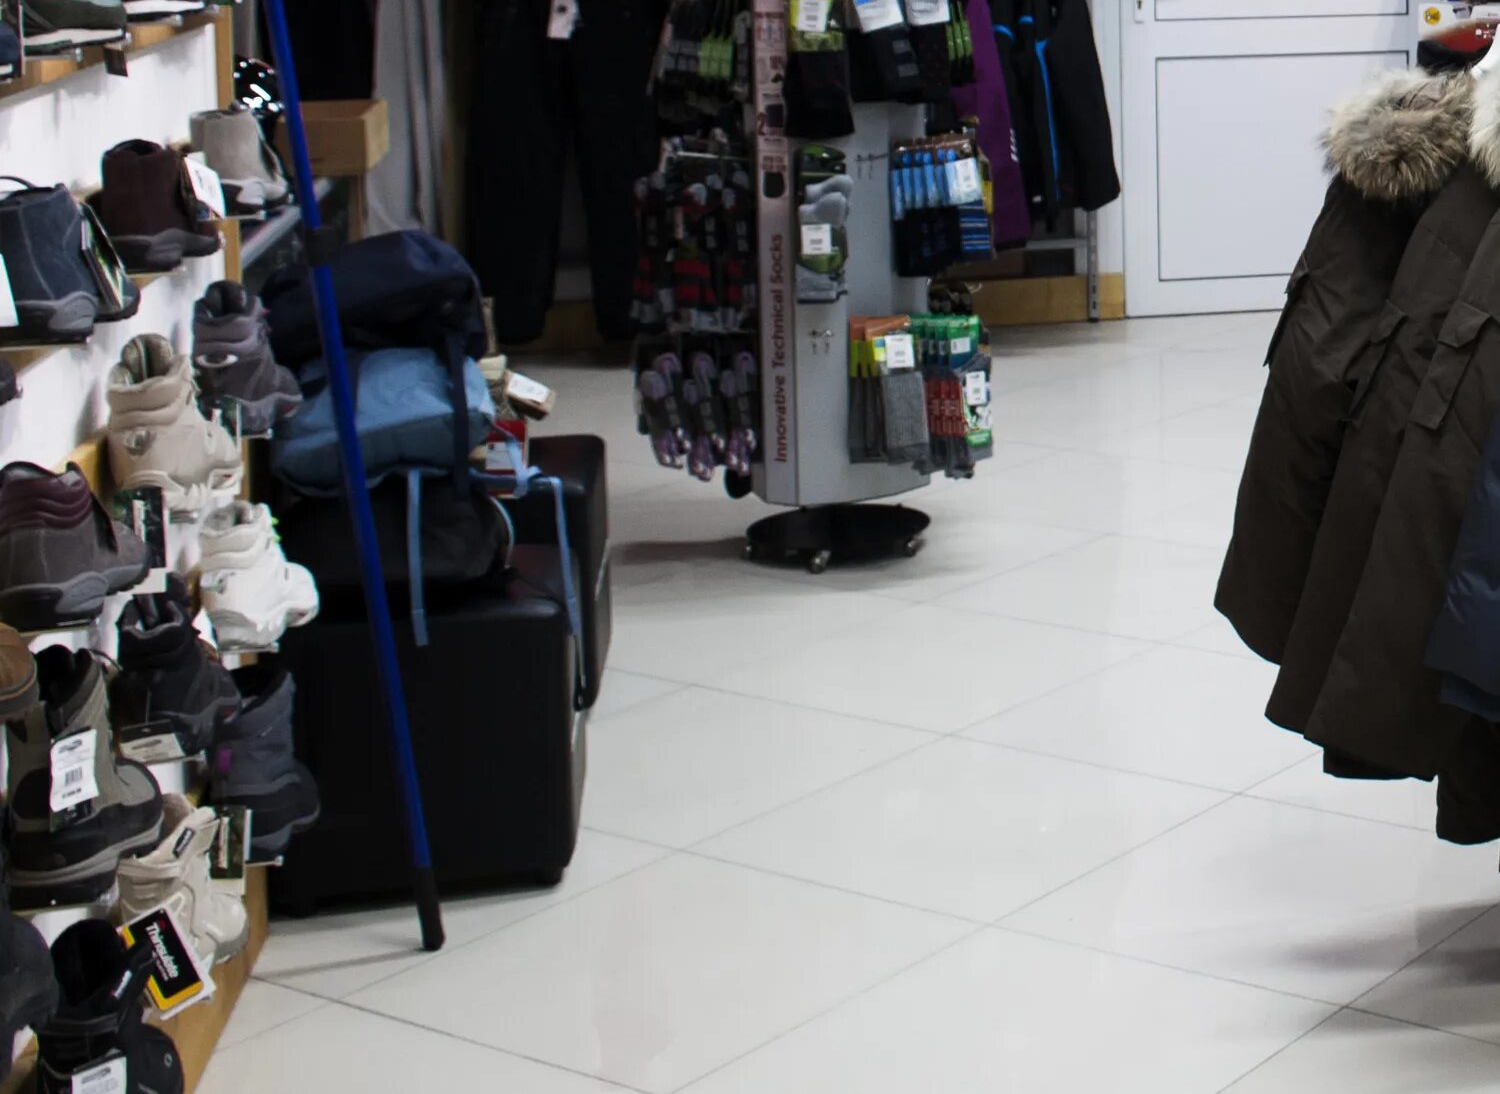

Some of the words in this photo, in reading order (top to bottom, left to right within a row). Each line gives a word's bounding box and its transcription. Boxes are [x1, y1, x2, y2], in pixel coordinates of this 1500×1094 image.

[769, 233, 784, 285] Socks
[771, 288, 785, 368] Technical
[774, 375, 788, 463] Innovative
[145, 921, 179, 979] Thinsulate
